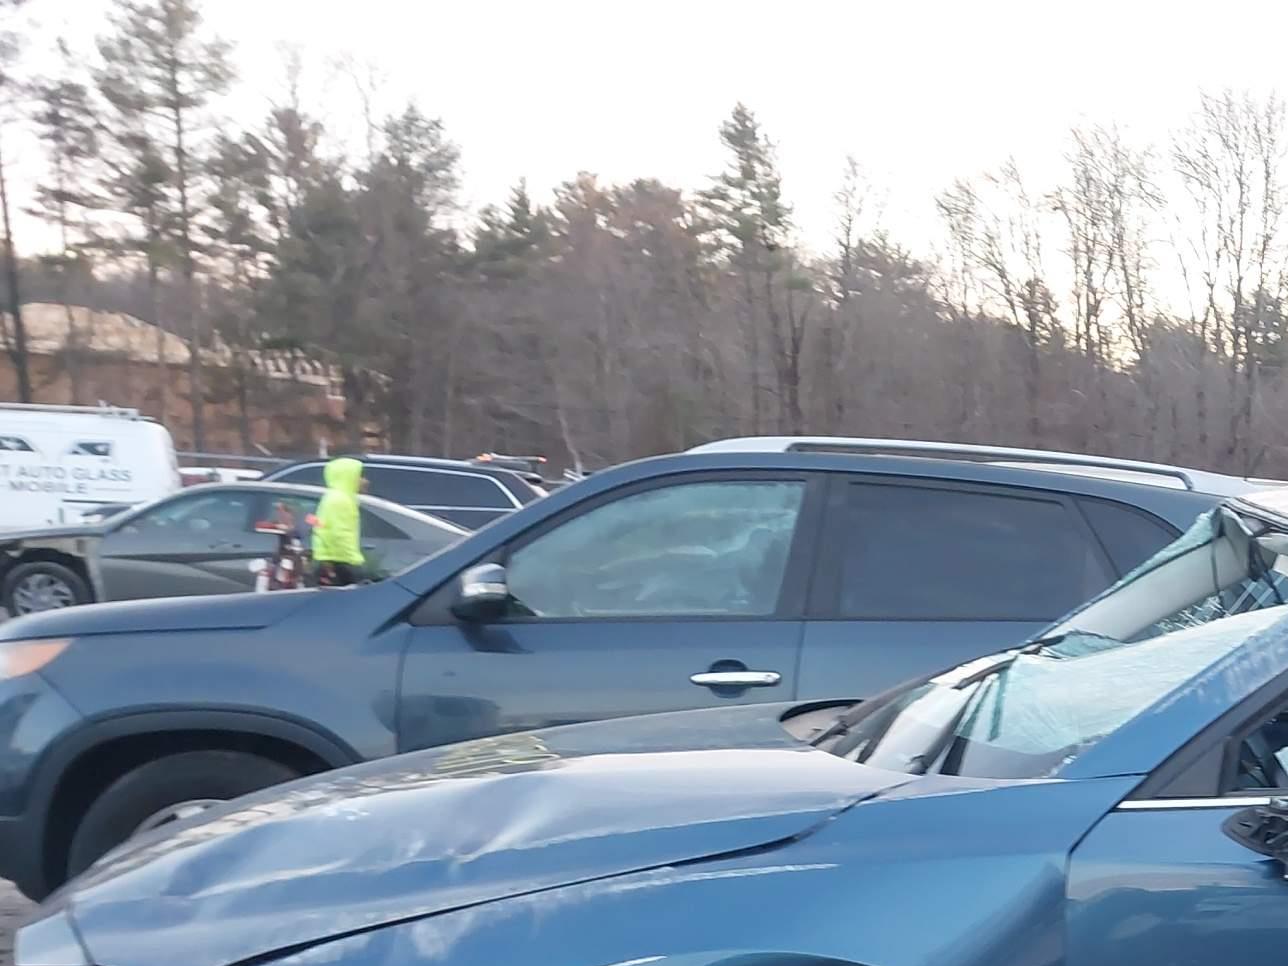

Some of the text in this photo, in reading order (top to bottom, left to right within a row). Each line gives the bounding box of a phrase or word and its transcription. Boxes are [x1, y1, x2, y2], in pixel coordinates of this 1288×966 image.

[16, 466, 66, 479] AUTO
[72, 467, 132, 482] GLASS
[9, 480, 88, 494] MOBILE
